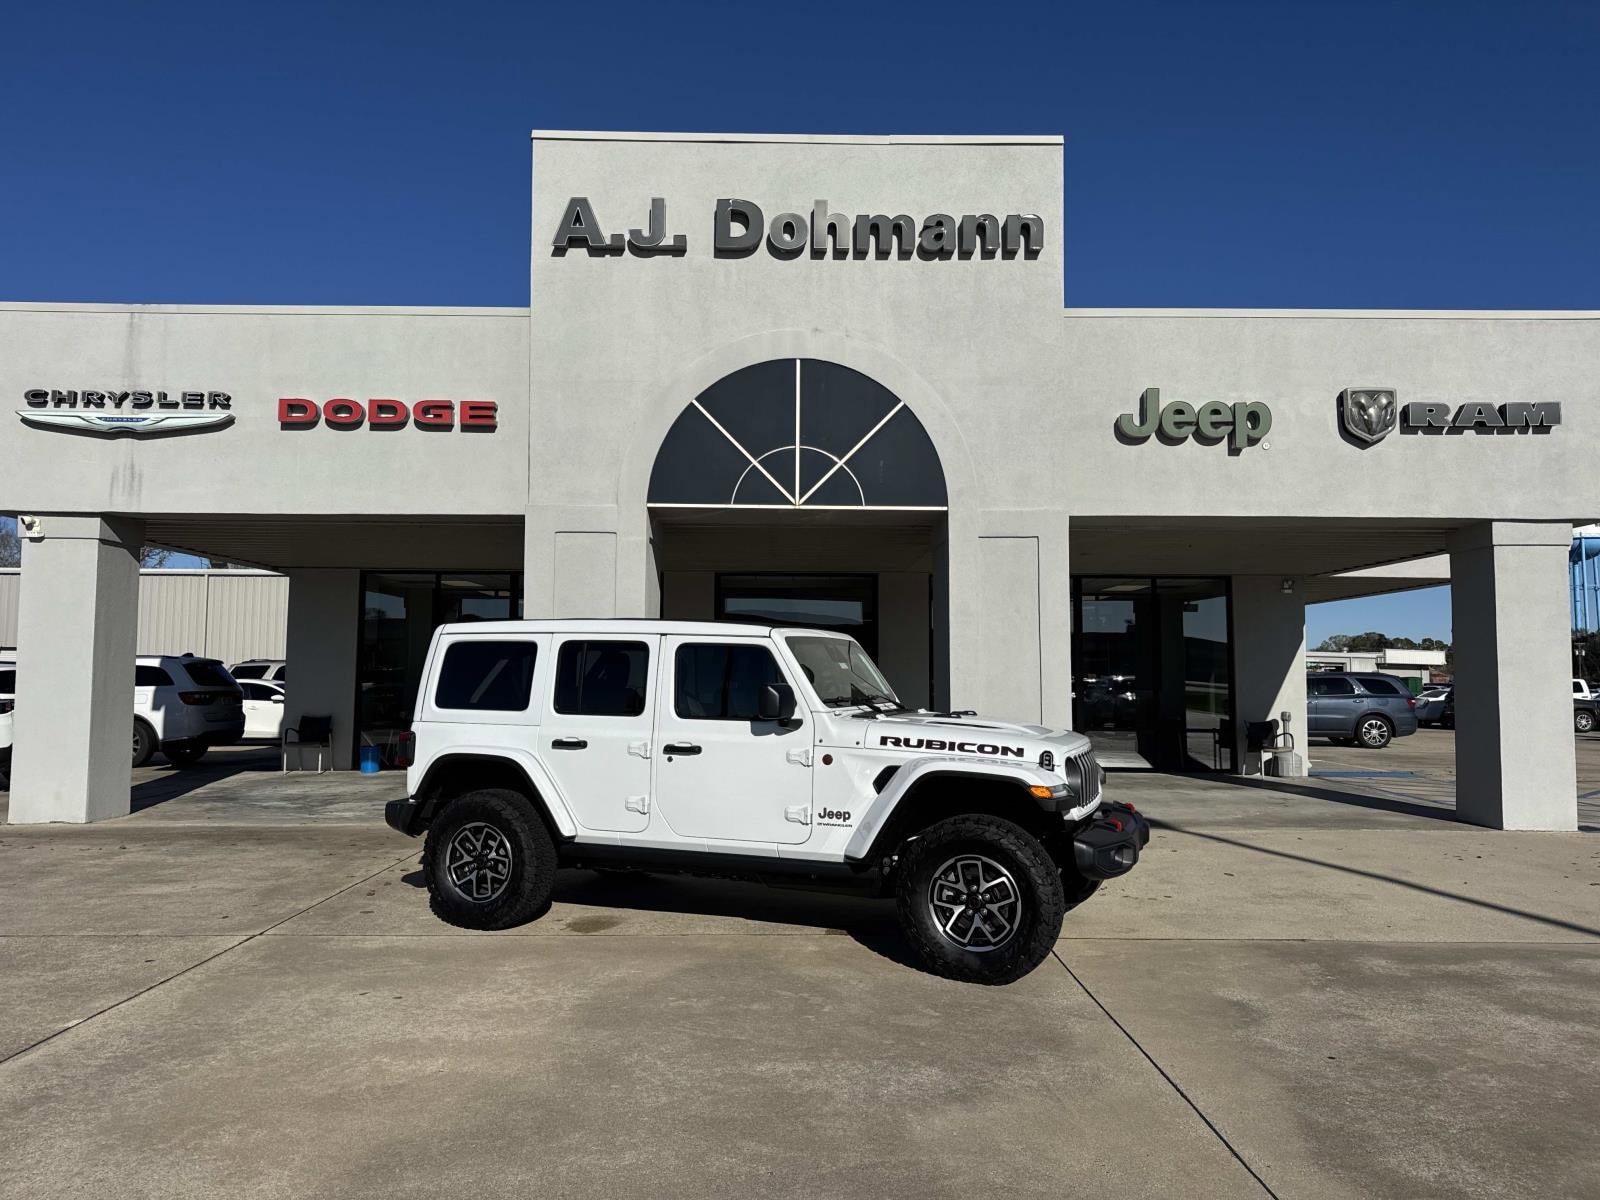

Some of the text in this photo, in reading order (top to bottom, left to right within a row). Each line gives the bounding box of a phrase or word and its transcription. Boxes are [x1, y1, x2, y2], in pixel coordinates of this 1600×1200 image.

[551, 197, 1045, 252] A.J. Dohmann
[24, 389, 231, 408] CHRYSLER
[278, 398, 498, 427] DODGE
[1117, 388, 1272, 450] Jeep
[1405, 402, 1562, 429] RAM
[880, 736, 1024, 757] RUBICON
[818, 807, 851, 822] Jeep
